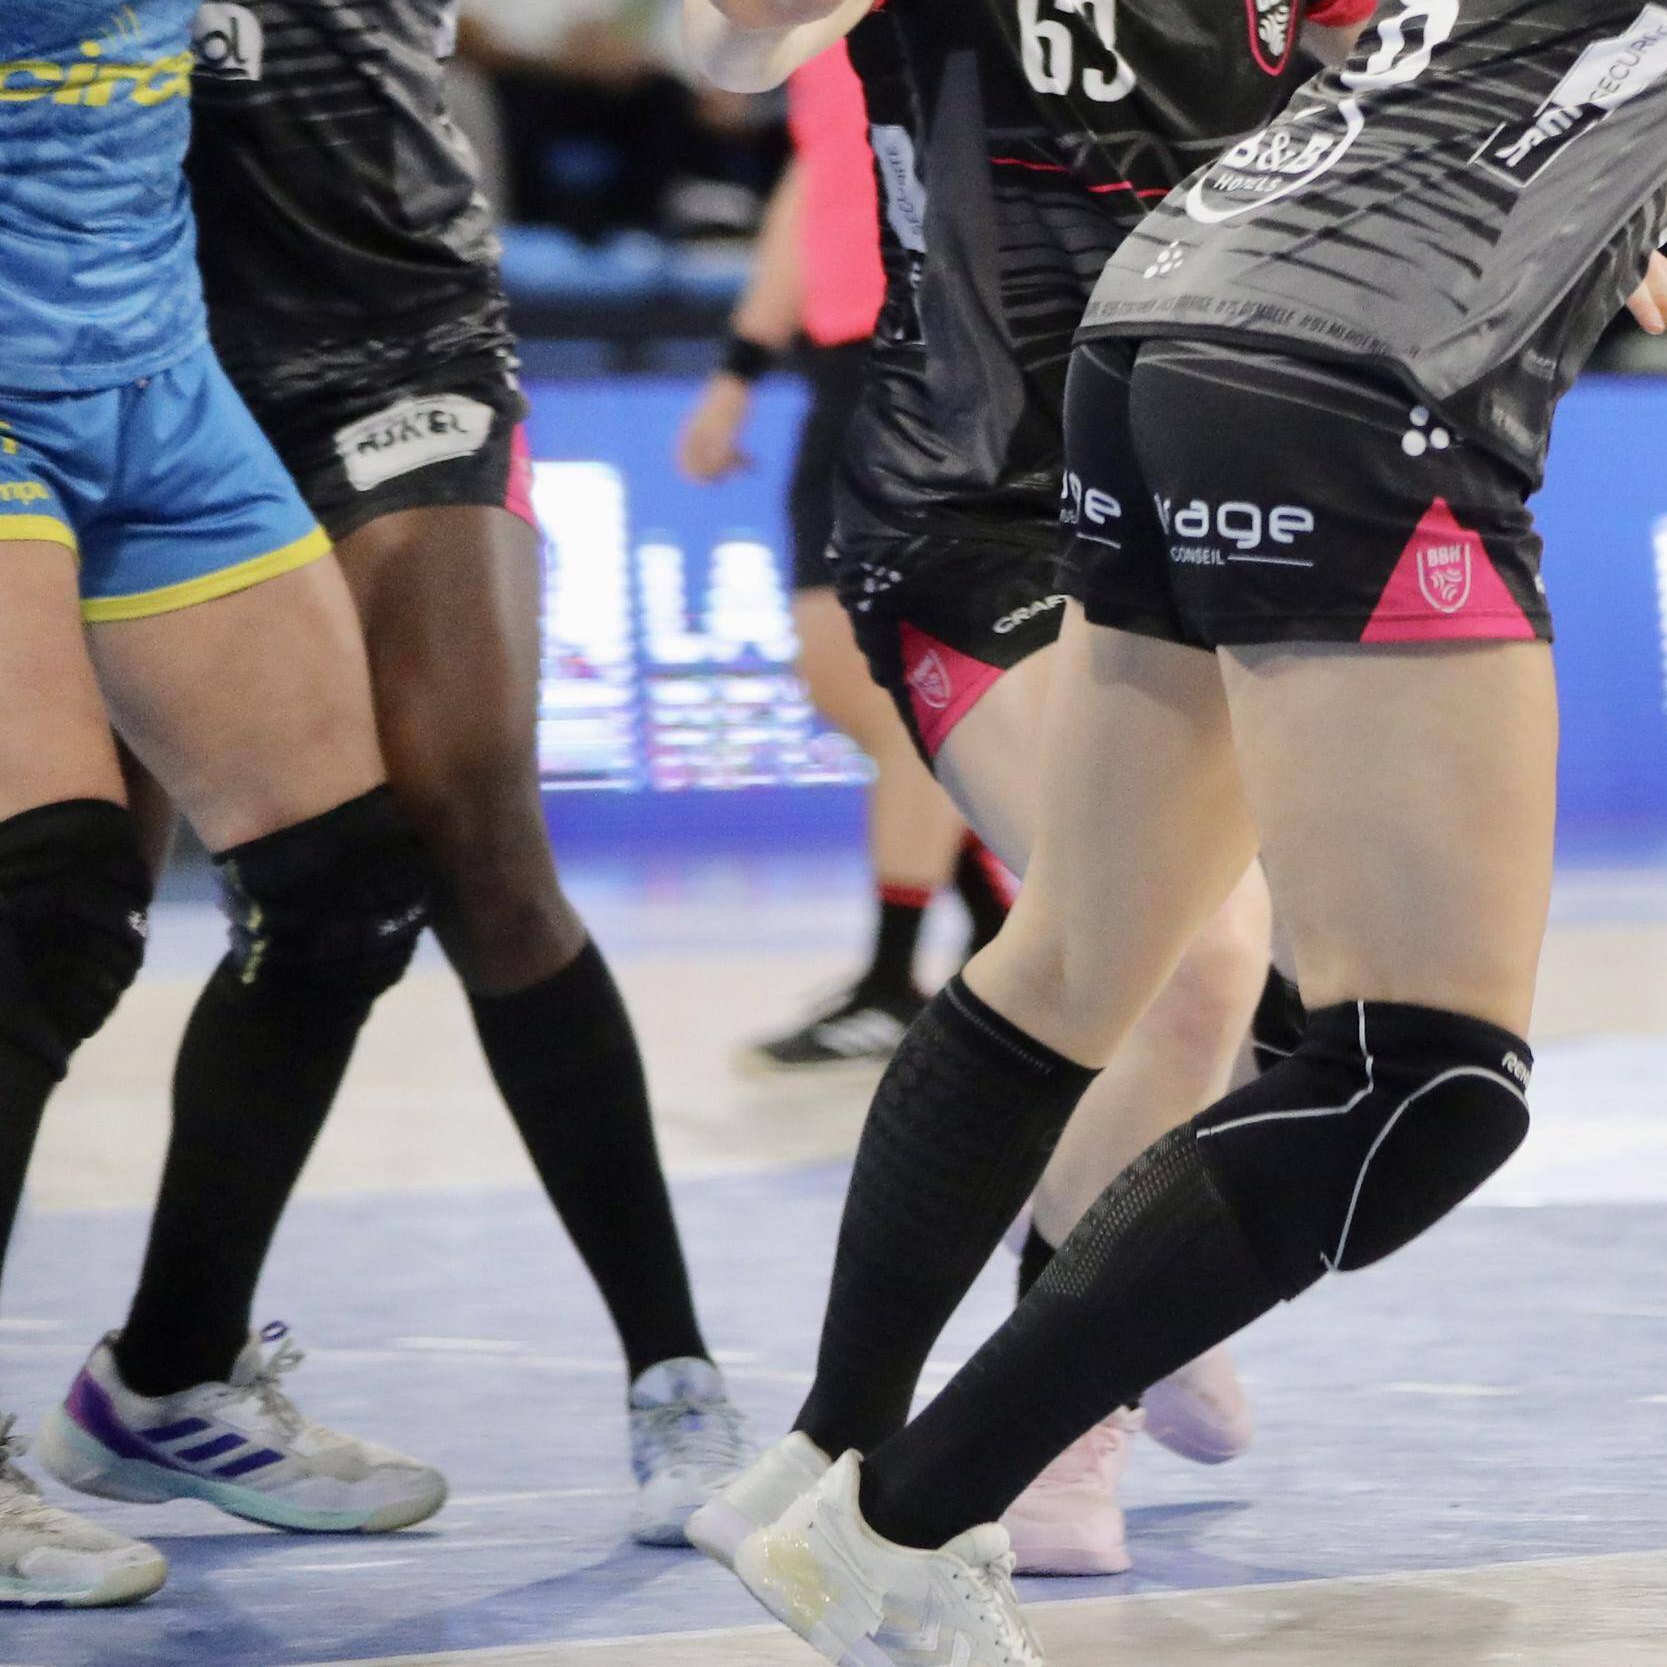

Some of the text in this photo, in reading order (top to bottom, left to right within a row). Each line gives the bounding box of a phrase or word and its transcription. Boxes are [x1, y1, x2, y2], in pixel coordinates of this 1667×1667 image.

[1061, 470, 1122, 525] ge
[1170, 545, 1226, 566] CONSEIL
[1427, 544, 1462, 567] BBH
